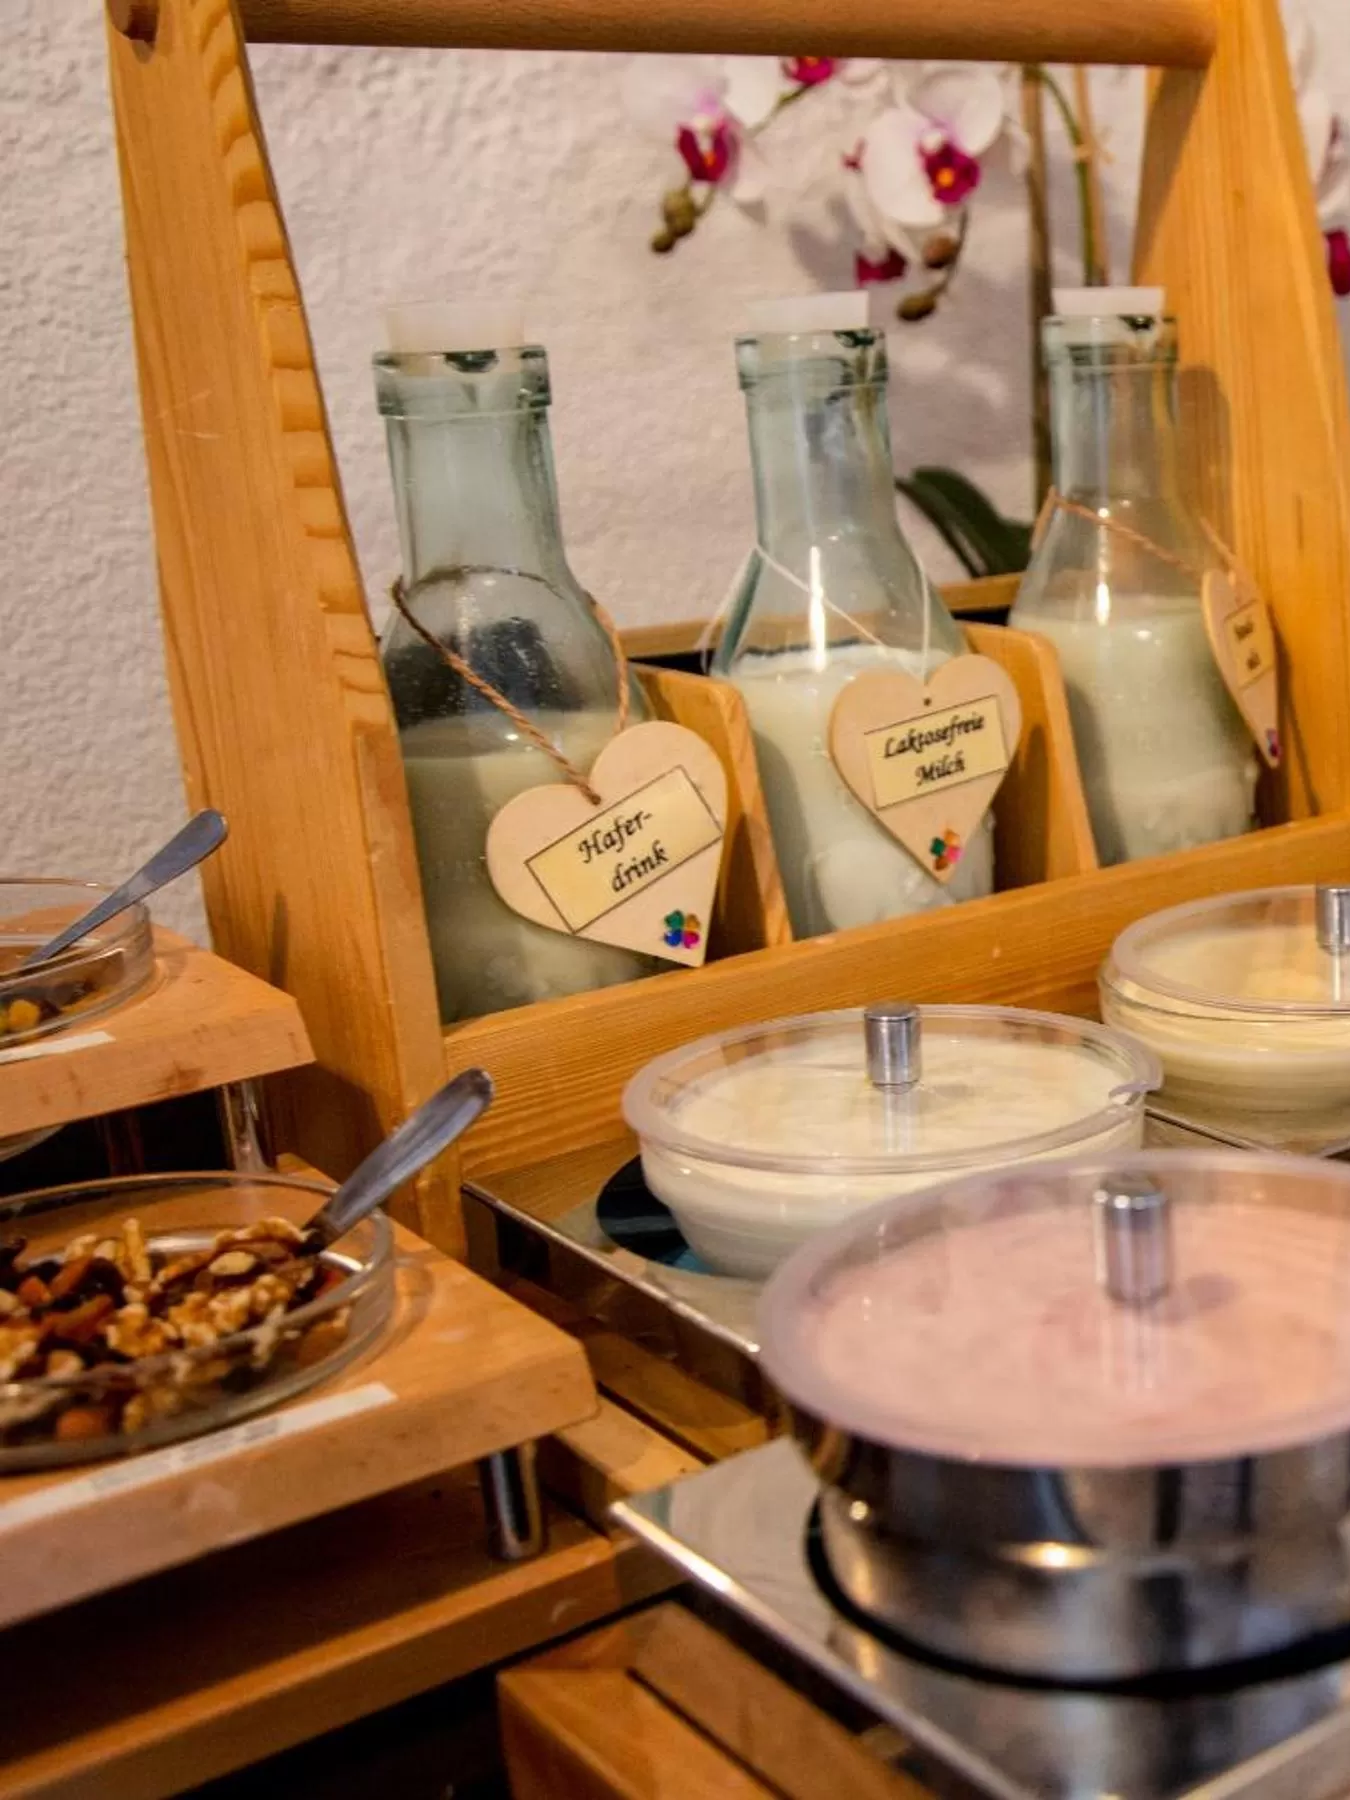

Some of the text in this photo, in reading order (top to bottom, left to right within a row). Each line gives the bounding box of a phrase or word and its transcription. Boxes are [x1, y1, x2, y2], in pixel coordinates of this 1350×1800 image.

[883, 711, 985, 758] Laktosefreie
[915, 749, 965, 787] Milch
[578, 810, 653, 864] Hafer-
[612, 839, 669, 892] drink
